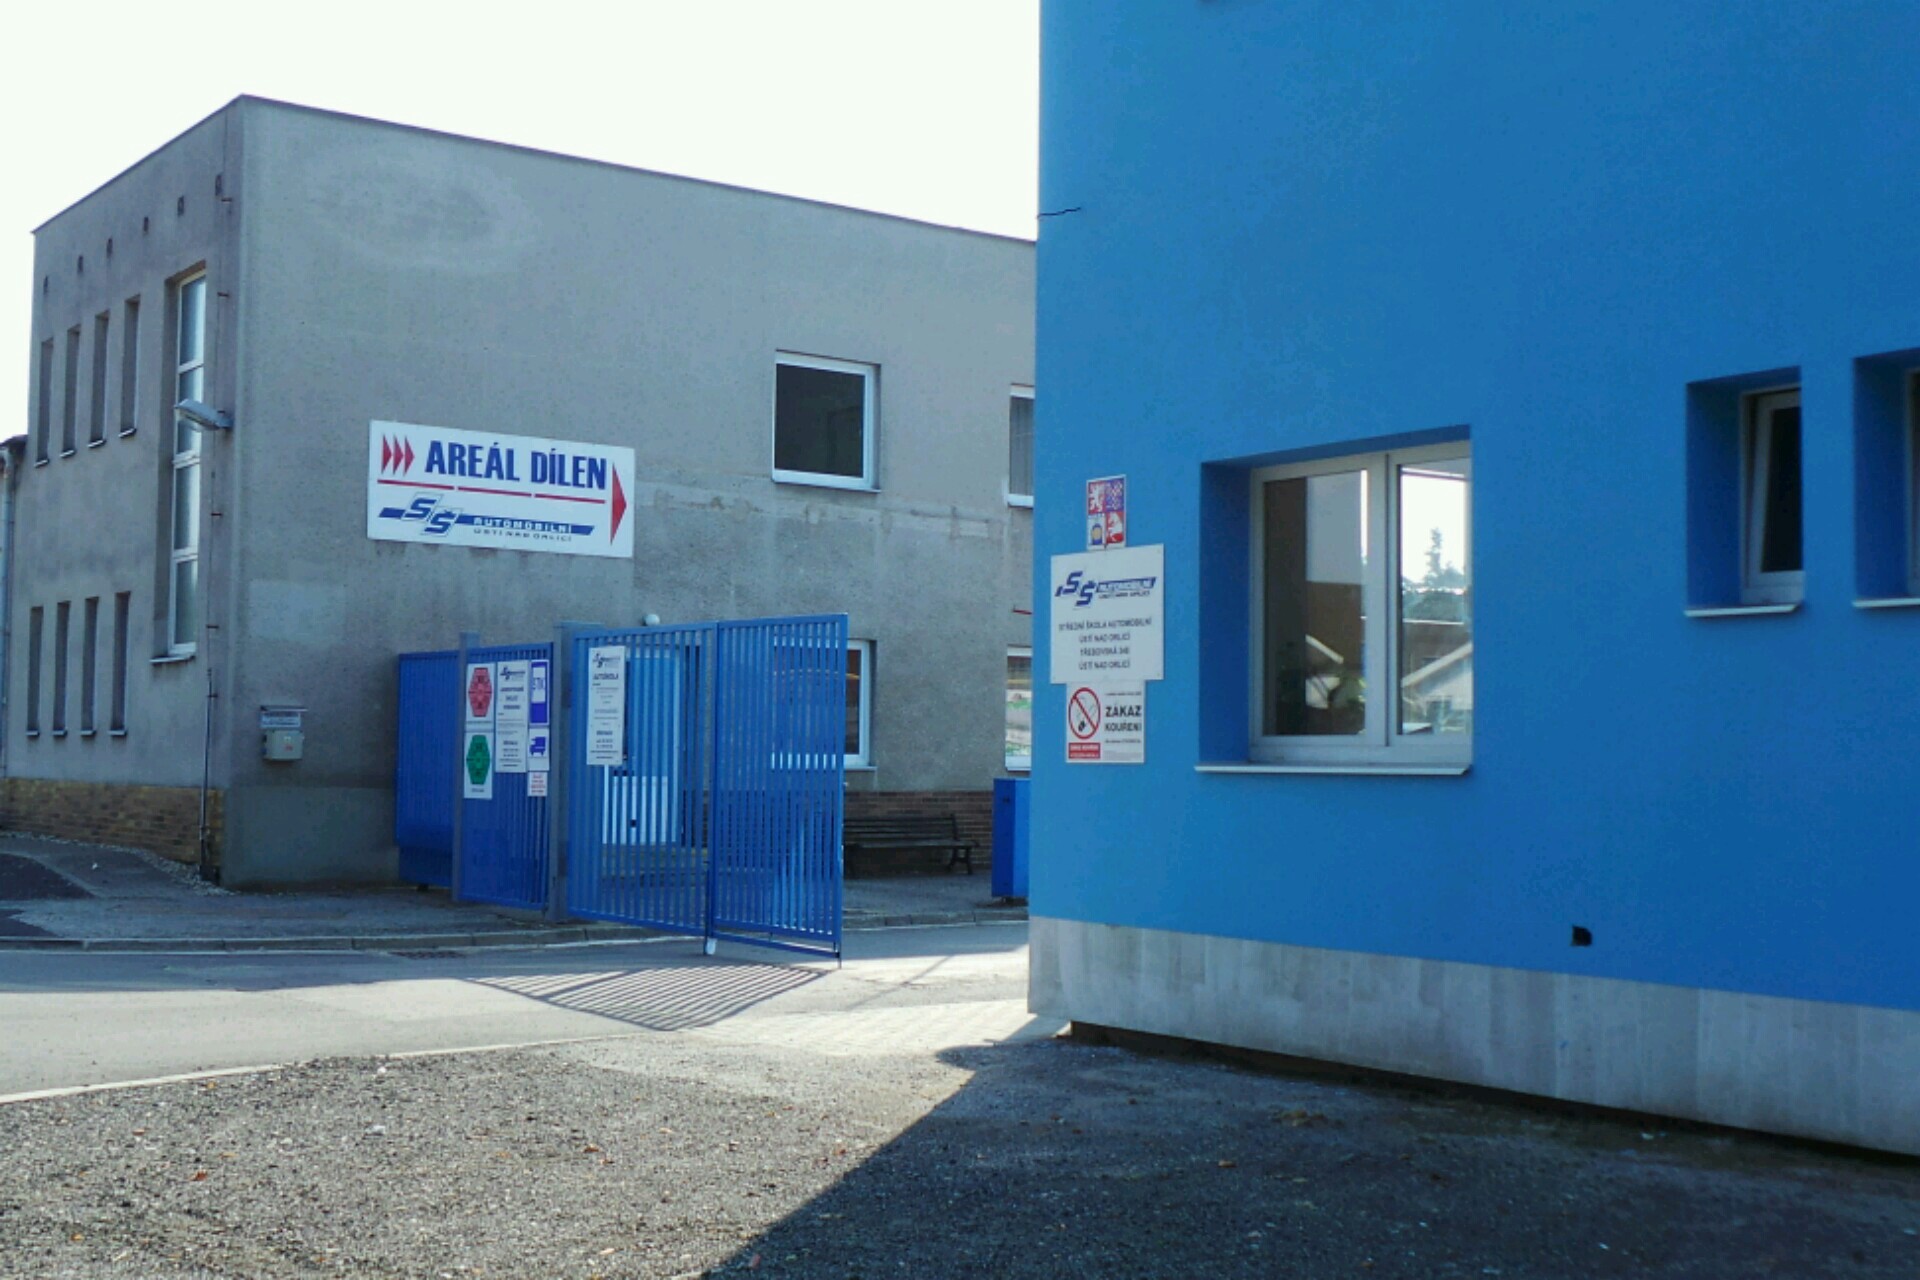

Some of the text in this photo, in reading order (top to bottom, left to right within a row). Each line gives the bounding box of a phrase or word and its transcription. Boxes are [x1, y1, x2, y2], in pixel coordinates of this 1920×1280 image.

[424, 440, 607, 490] AREÁL DÍLEN
[473, 516, 573, 534] AUTOMOBILNÍ
[1105, 703, 1142, 717] ZÁKAZ
[1104, 719, 1142, 732] KOUŘENÍ
